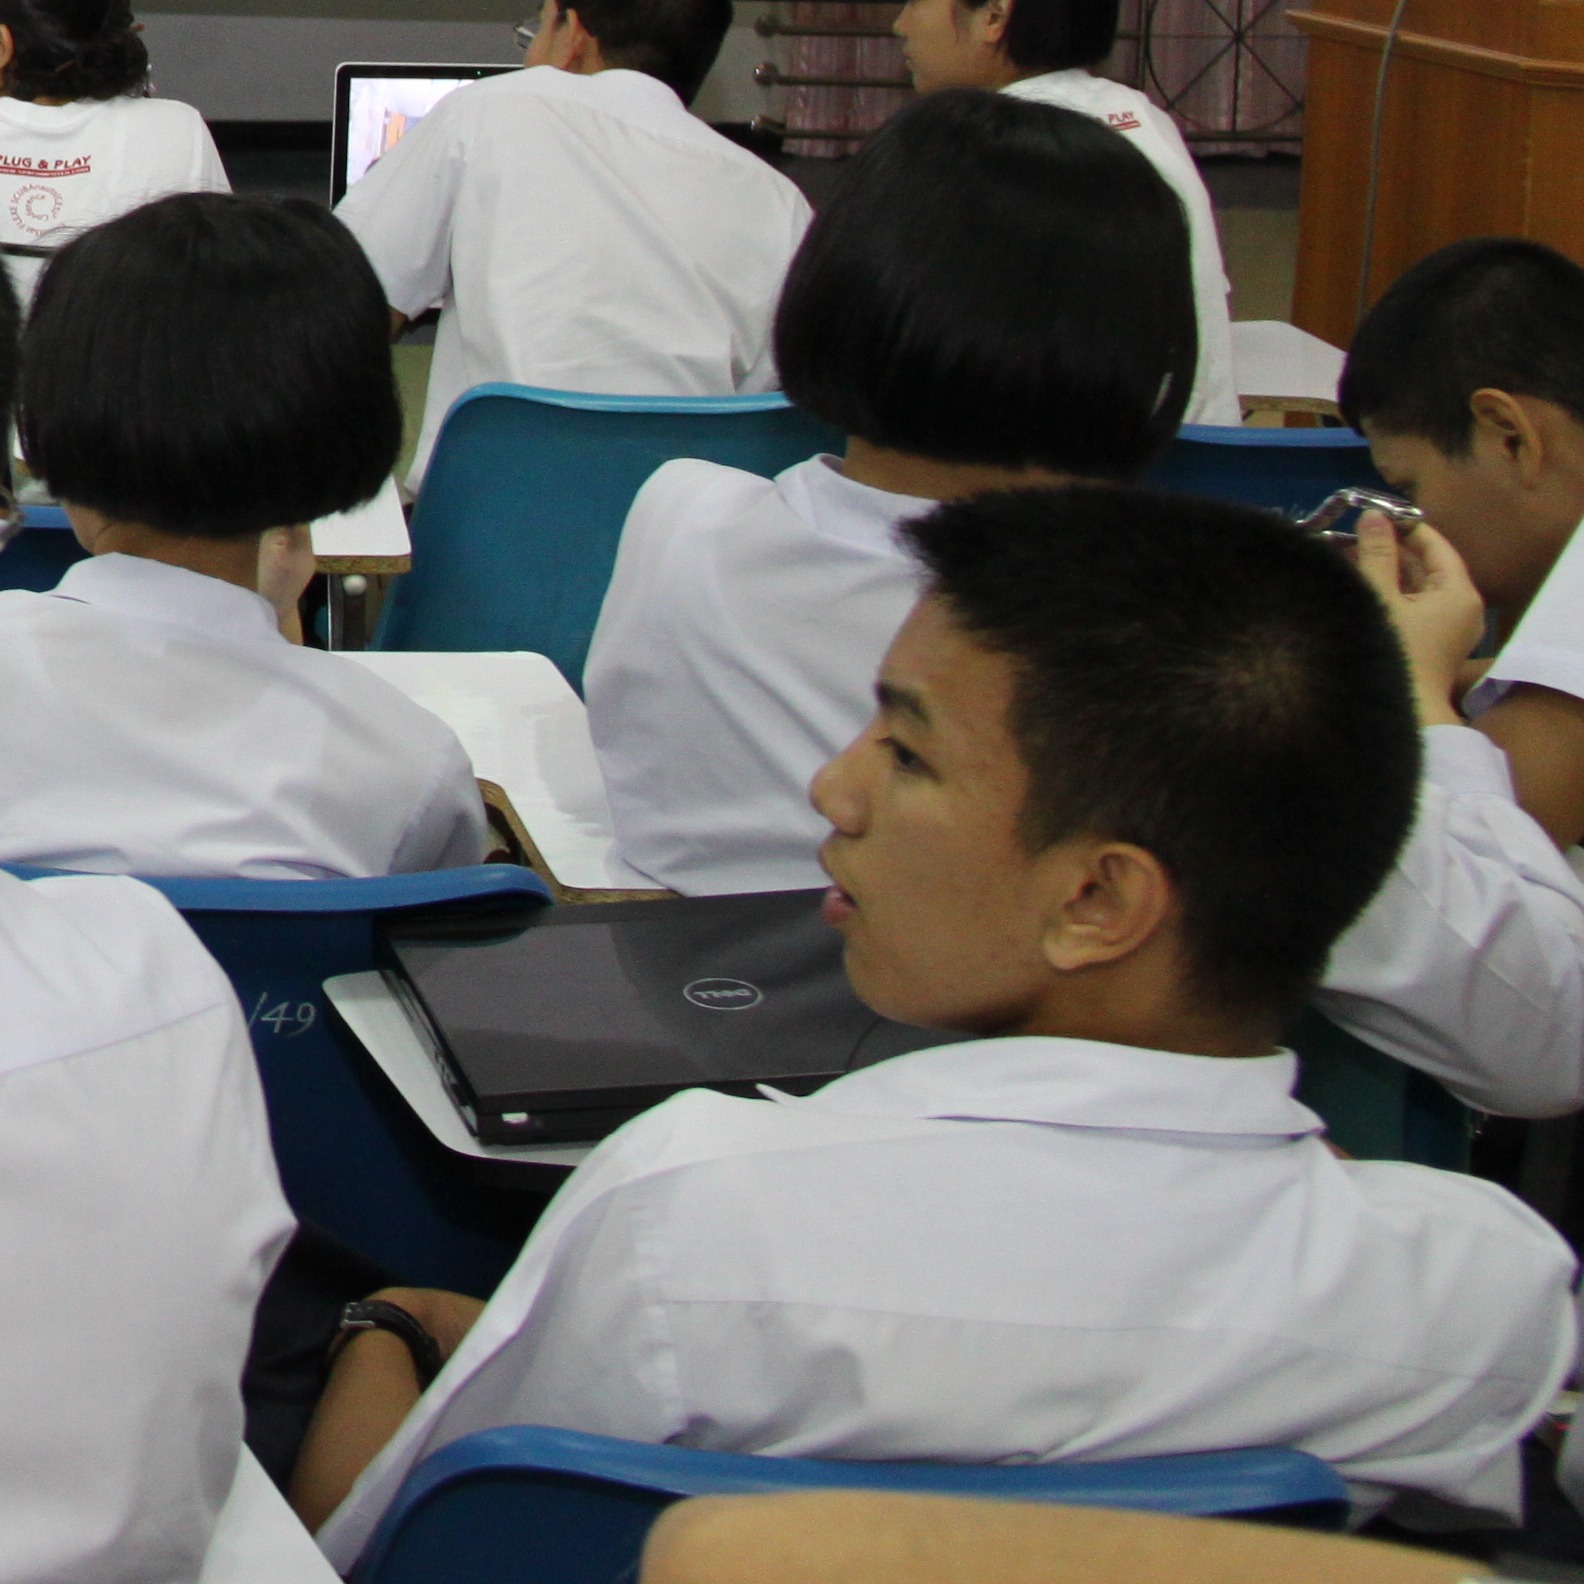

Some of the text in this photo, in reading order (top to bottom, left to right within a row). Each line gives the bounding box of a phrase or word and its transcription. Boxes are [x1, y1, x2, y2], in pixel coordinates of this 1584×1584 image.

[1108, 111, 1134, 124] PLAY
[38, 159, 49, 170] &
[54, 154, 92, 170] PLAY
[248, 991, 319, 1038] /49
